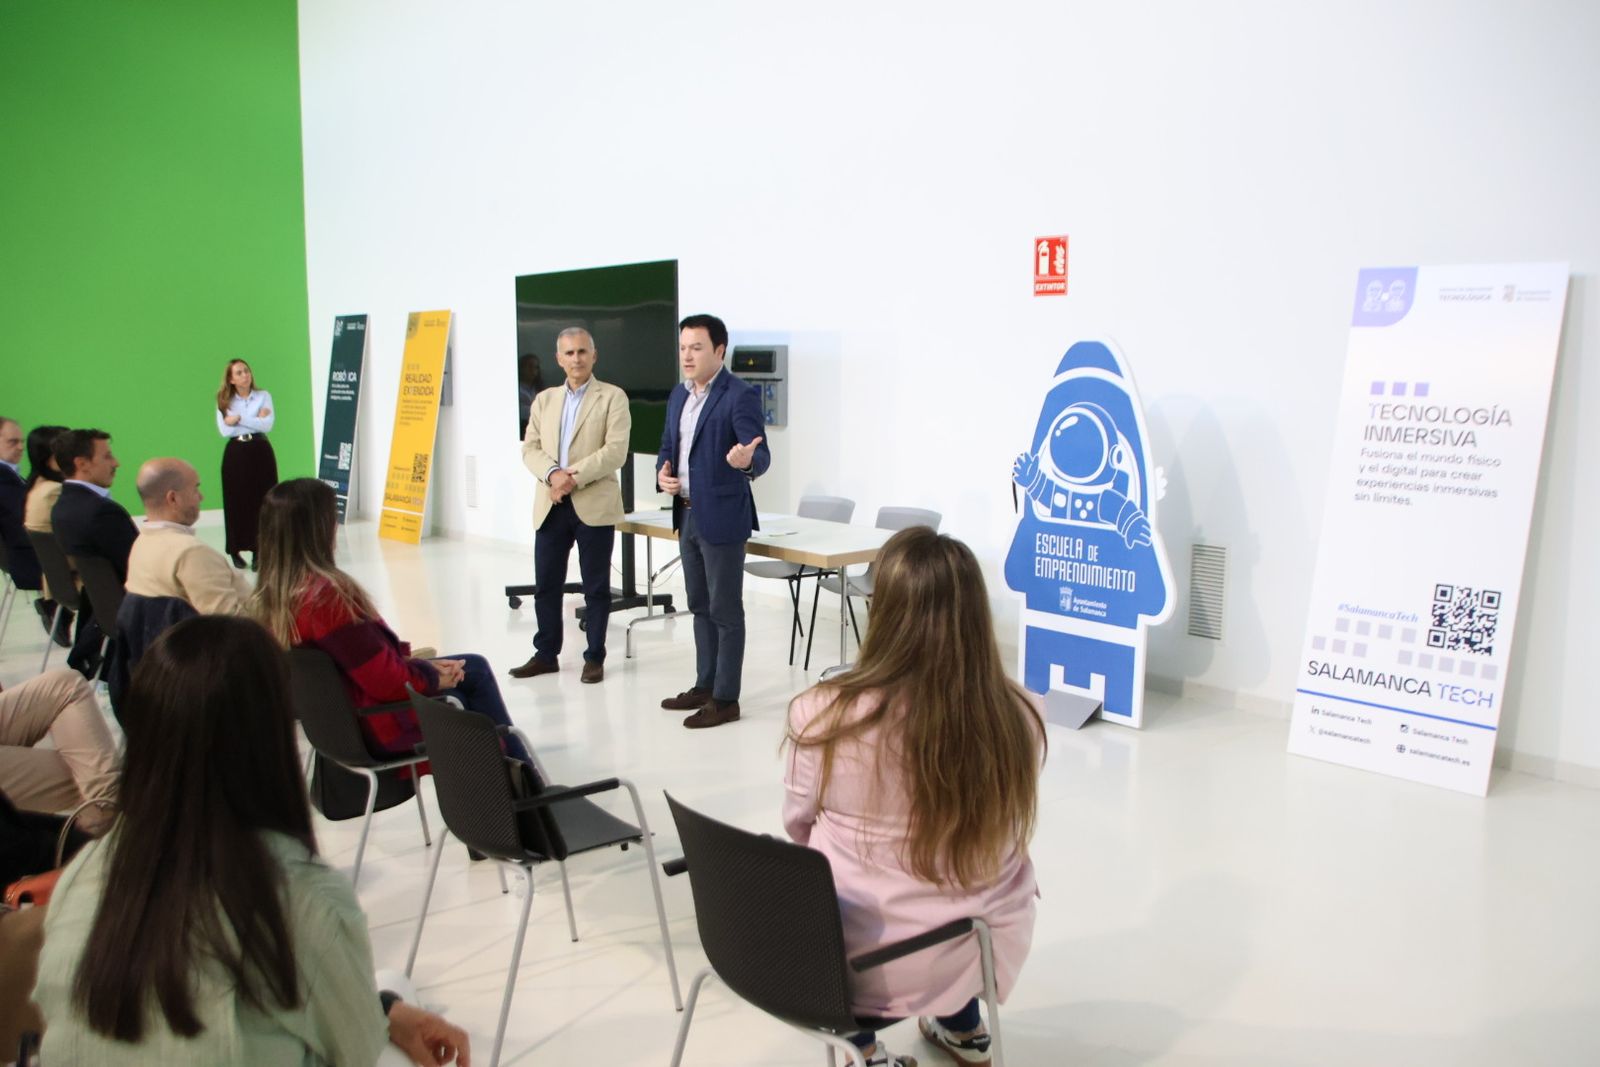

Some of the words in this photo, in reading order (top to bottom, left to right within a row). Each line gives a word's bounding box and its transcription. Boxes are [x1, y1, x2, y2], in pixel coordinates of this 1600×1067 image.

[332, 370, 357, 381] ROBÓICA
[1369, 402, 1513, 427] TECNOLOGÍA
[1363, 424, 1478, 448] INMERSIVA
[1360, 448, 1403, 461] Fusiona
[1407, 450, 1418, 461] el
[1420, 453, 1463, 466] mundo
[1359, 464, 1366, 474] y
[1368, 464, 1379, 474] el
[1381, 464, 1417, 478] digital
[1419, 468, 1448, 480] para
[1450, 470, 1483, 482] crear
[1354, 492, 1370, 503] sin
[1355, 478, 1430, 494] experiencias
[1433, 482, 1499, 499] inmersivas
[1036, 533, 1083, 559] ESCUELA
[1088, 546, 1099, 562] DE
[1035, 557, 1136, 592] EMPRENDIMIENTO
[1073, 597, 1107, 609] Ayuntamiento
[1338, 603, 1419, 622] #SalamancaTech
[1307, 659, 1433, 698] SALAMANCA
[1437, 682, 1494, 709] TECH
